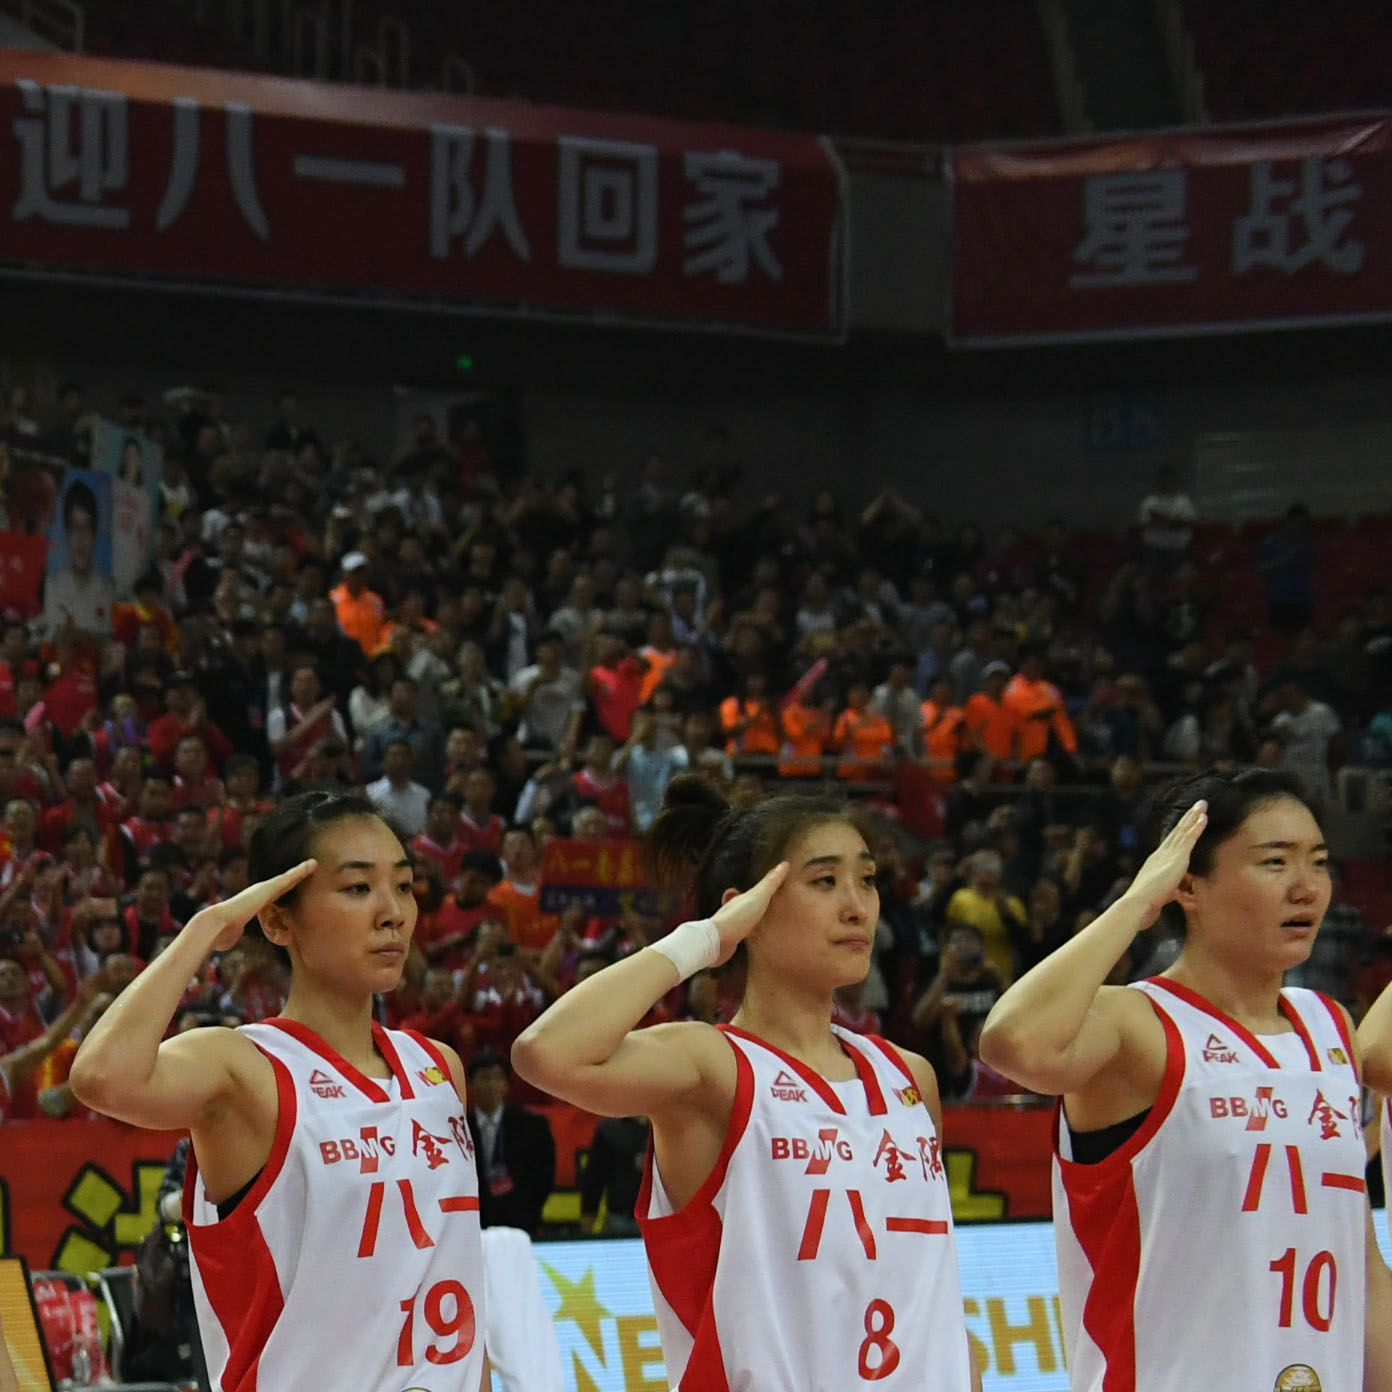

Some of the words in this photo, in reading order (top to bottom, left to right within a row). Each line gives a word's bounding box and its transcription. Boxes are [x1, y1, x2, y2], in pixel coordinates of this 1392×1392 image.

[1202, 1049, 1240, 1065] PEAK
[771, 1086, 808, 1103] PEAK
[1211, 1091, 1289, 1126] BBMG
[319, 1130, 396, 1169] BBMG
[771, 1132, 853, 1169] BBMG
[1241, 1143, 1366, 1215] 八一
[357, 1178, 480, 1258] 八一
[797, 1188, 948, 1261] 八一
[396, 1279, 476, 1367] 19
[1269, 1247, 1338, 1333] 10
[858, 1298, 901, 1381] 8
